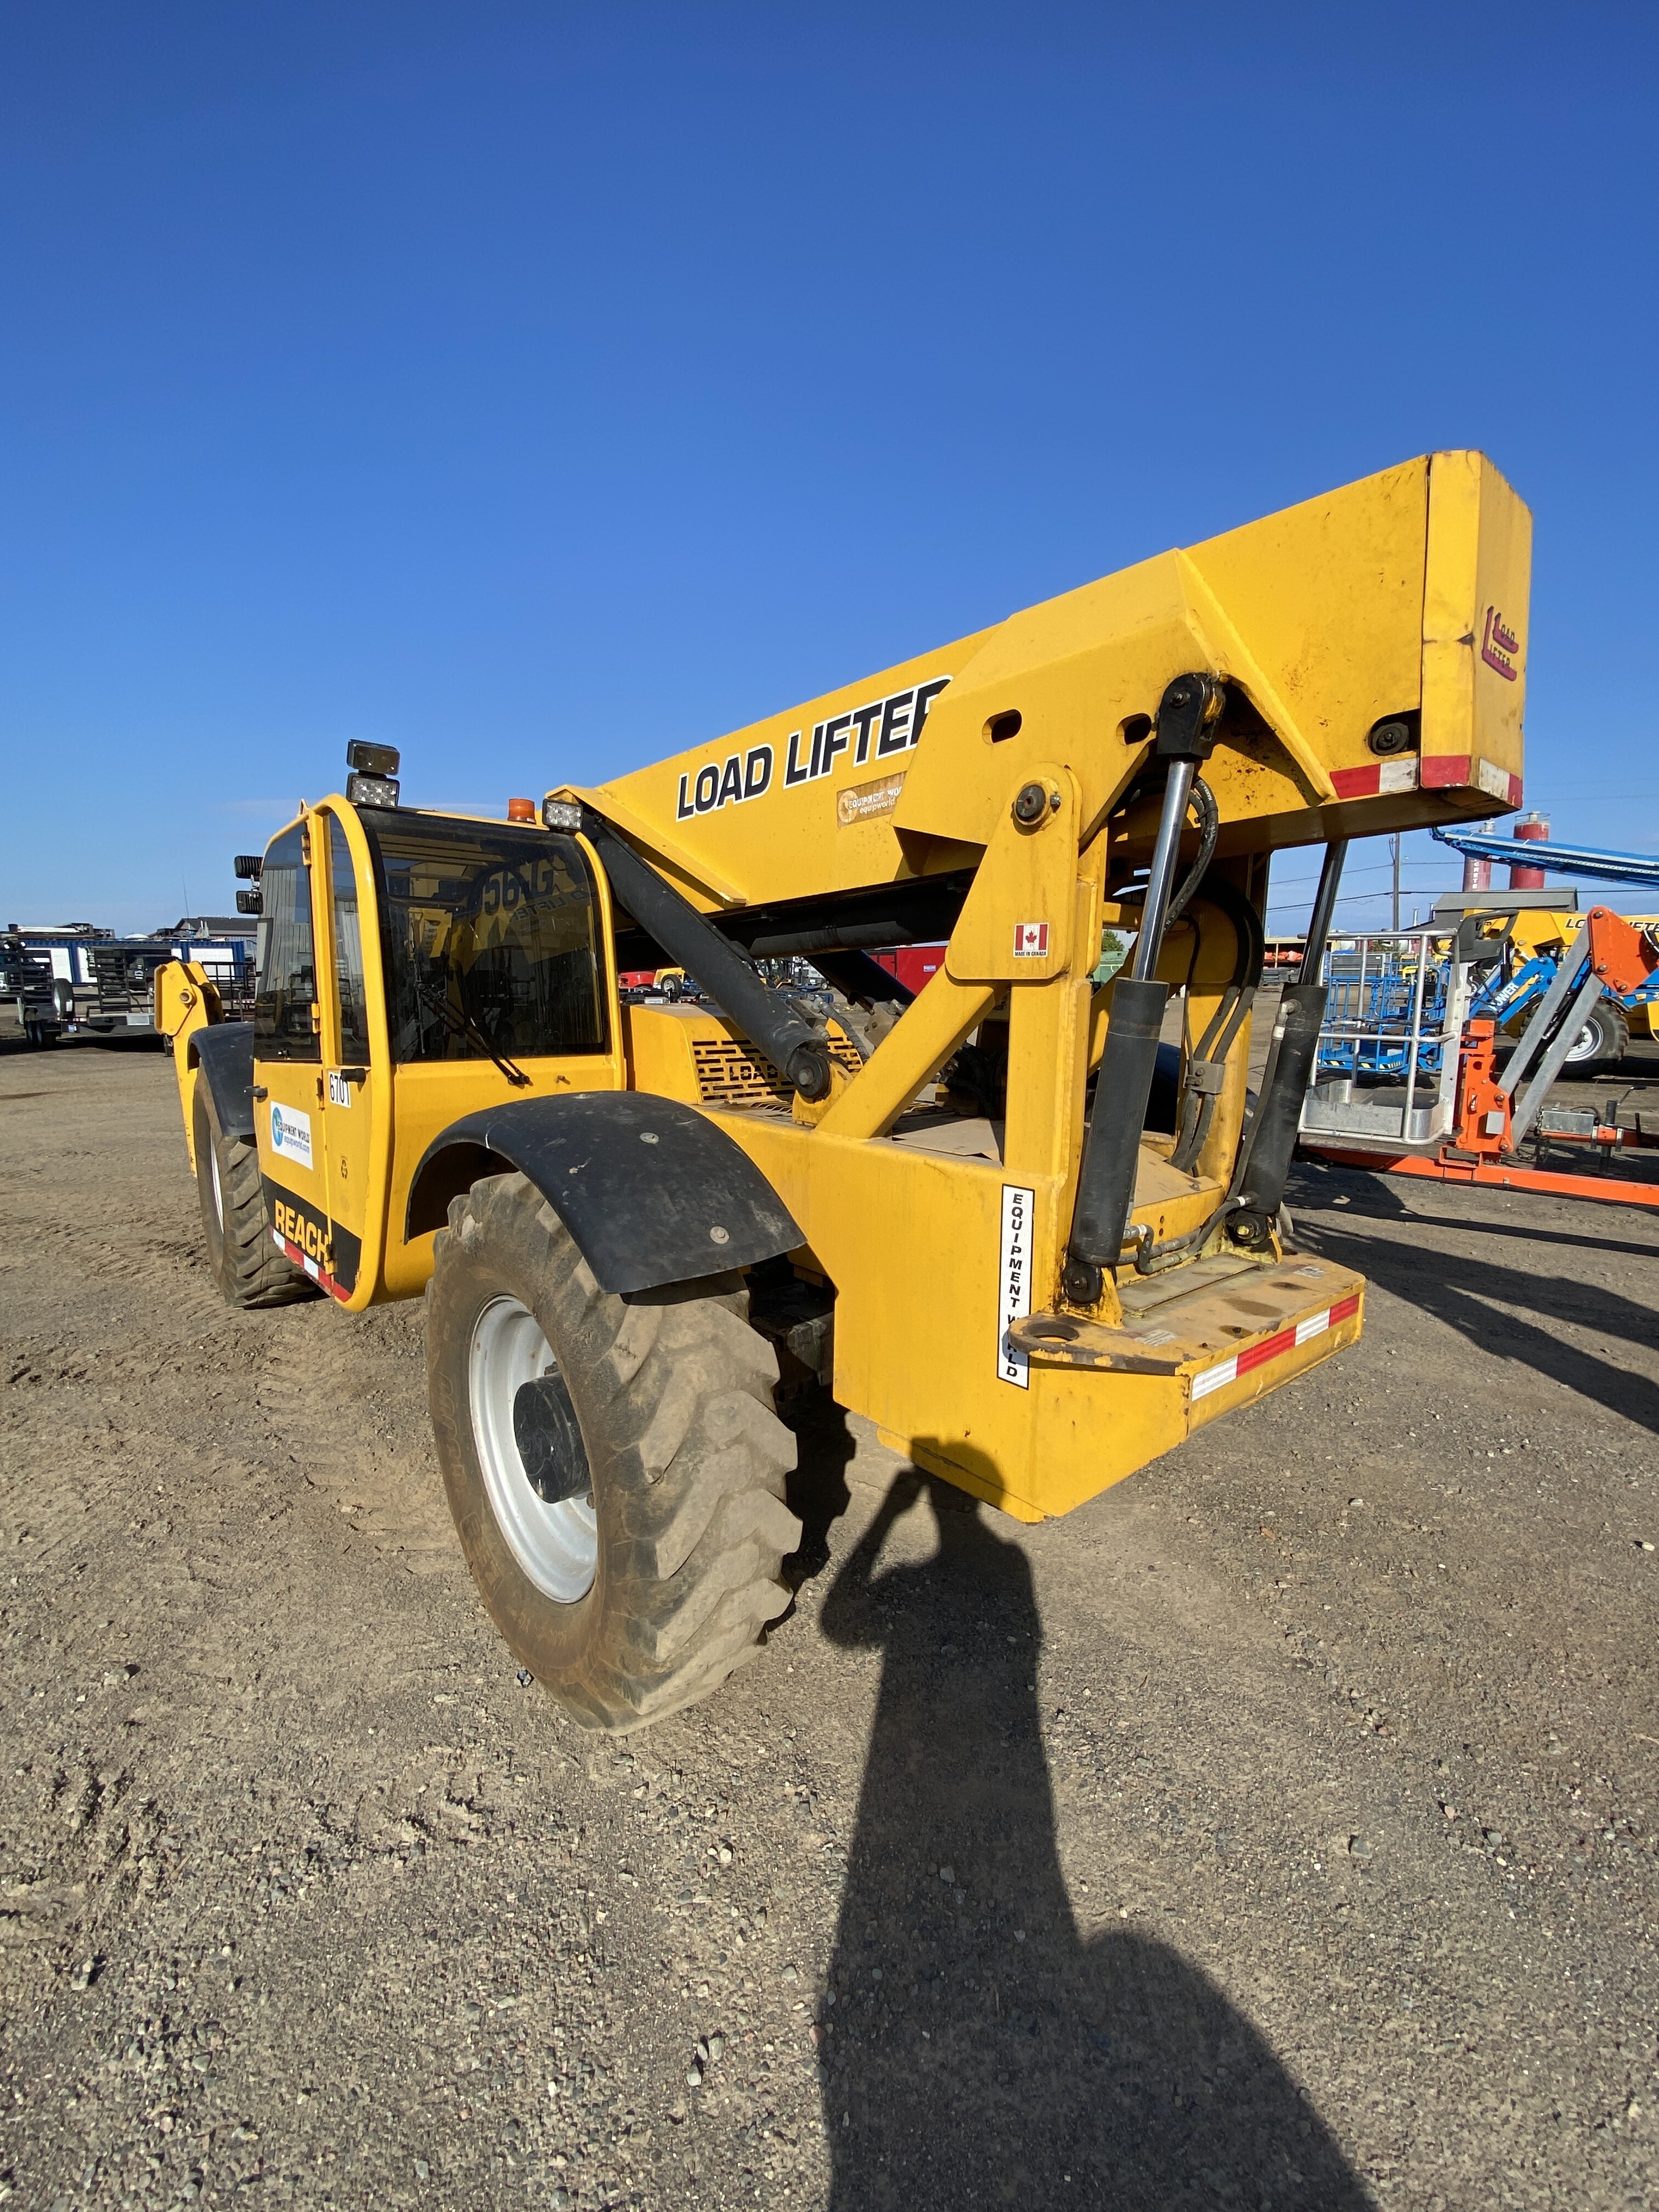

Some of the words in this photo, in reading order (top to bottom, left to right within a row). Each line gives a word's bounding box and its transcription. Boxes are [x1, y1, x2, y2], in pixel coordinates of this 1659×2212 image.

[676, 743, 774, 822] LOAD
[849, 791, 885, 809] EQUIPMENT
[729, 1064, 778, 1081] LOAD
[330, 1074, 349, 1106] 6701
[278, 1121, 297, 1137] EQUIPMENT
[297, 1128, 309, 1143] WORLD
[275, 1199, 329, 1267] REACH
[1009, 1193, 1024, 1307] EQUIPMENT
